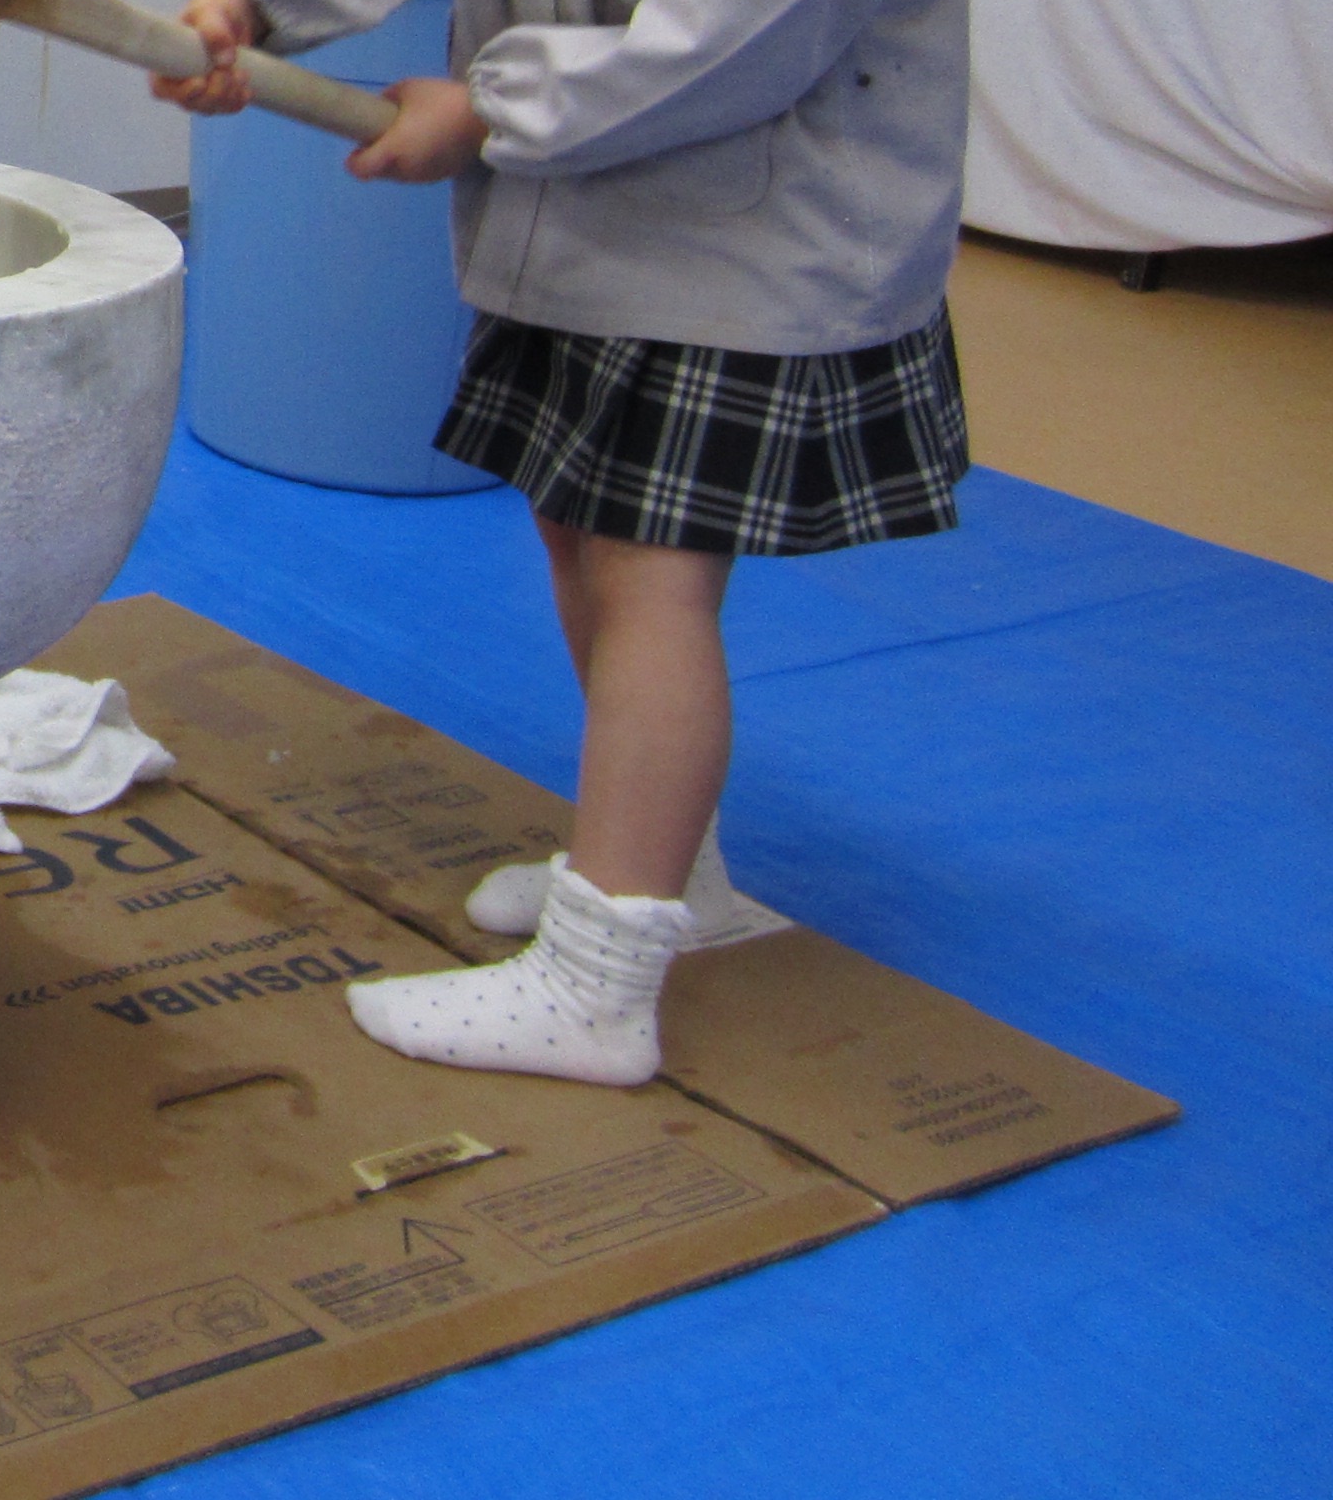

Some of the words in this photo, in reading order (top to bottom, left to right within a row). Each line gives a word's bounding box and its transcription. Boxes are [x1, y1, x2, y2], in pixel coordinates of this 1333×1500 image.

[209, 920, 330, 961] Leading
[60, 943, 209, 992] Innovation
[93, 945, 381, 1026] TOSHIBA
